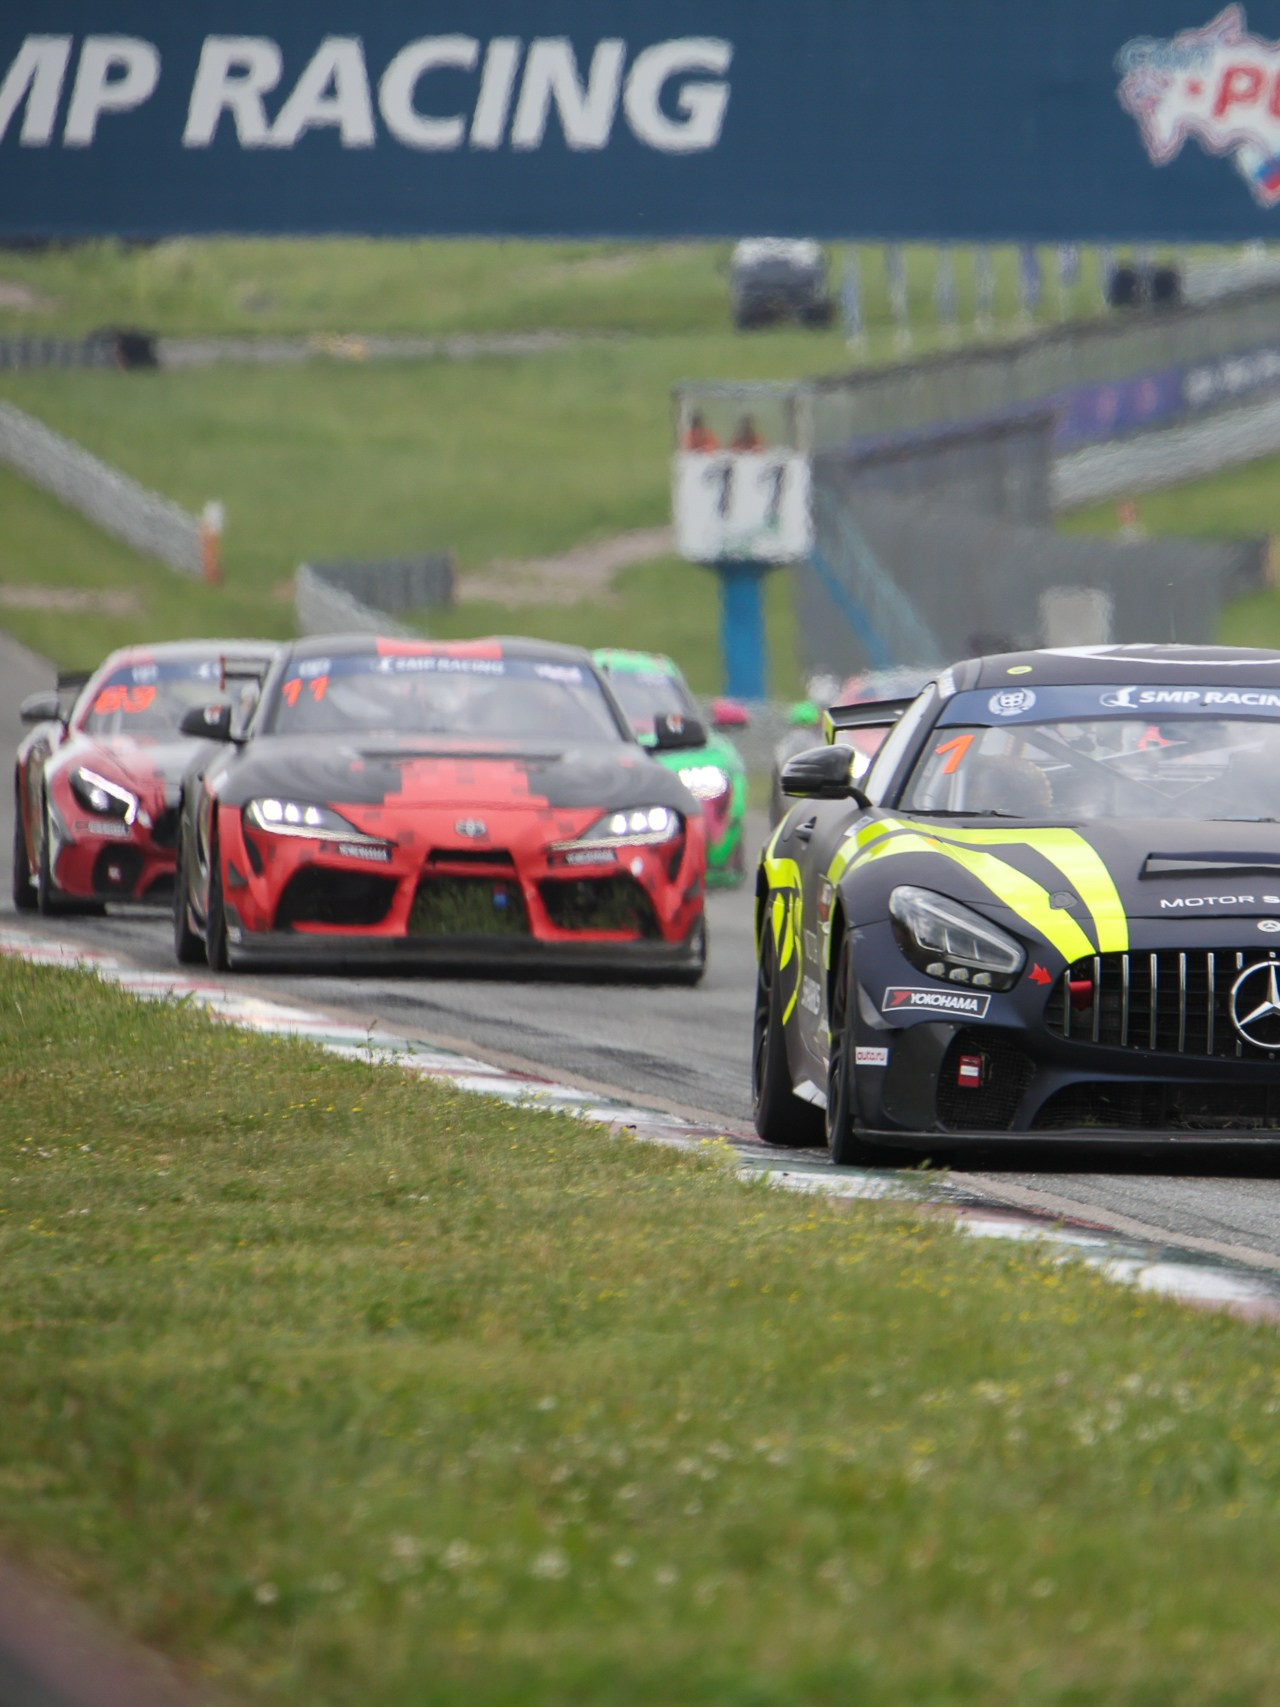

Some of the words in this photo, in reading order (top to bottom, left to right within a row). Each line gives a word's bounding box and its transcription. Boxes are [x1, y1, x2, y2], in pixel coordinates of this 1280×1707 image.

[181, 34, 734, 153] RACING
[282, 675, 329, 707] 11
[1139, 690, 1201, 704] SMP
[935, 734, 975, 774] 1
[1159, 895, 1255, 909] MOTOR
[911, 993, 978, 1011] YOKOHAMA
